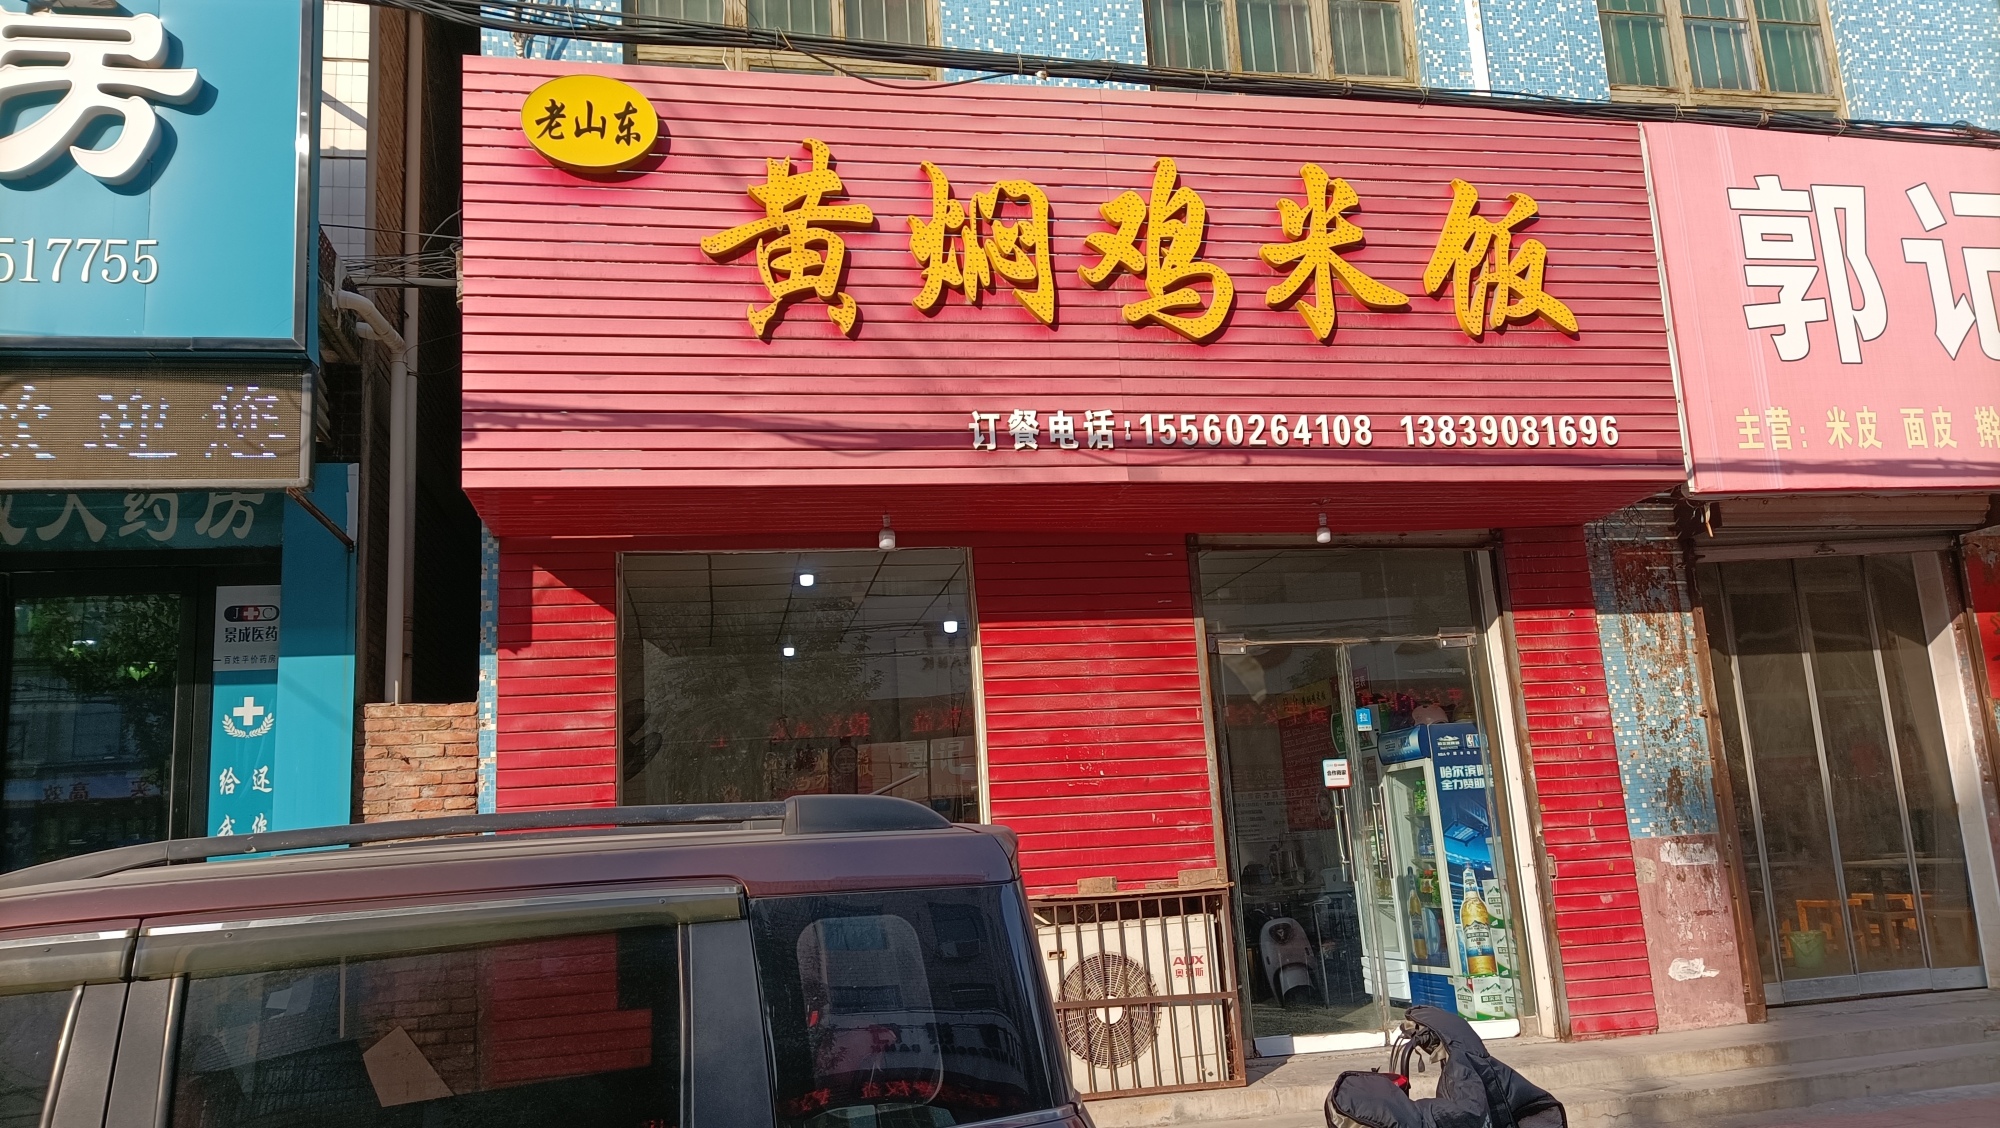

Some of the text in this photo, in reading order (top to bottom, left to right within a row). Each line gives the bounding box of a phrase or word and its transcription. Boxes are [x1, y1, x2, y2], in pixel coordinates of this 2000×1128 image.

[535, 99, 641, 146] 老山东
[700, 138, 1580, 342] 黄焖鸡米饭
[1726, 174, 2000, 364] 郭记
[1400, 415, 1619, 446] 13839081696
[1826, 406, 1883, 449] 米皮
[1900, 405, 1958, 449] 面皮
[224, 625, 279, 643] 景成医药
[223, 654, 277, 665] 百姓平价药房
[1173, 955, 1204, 966] AUX
